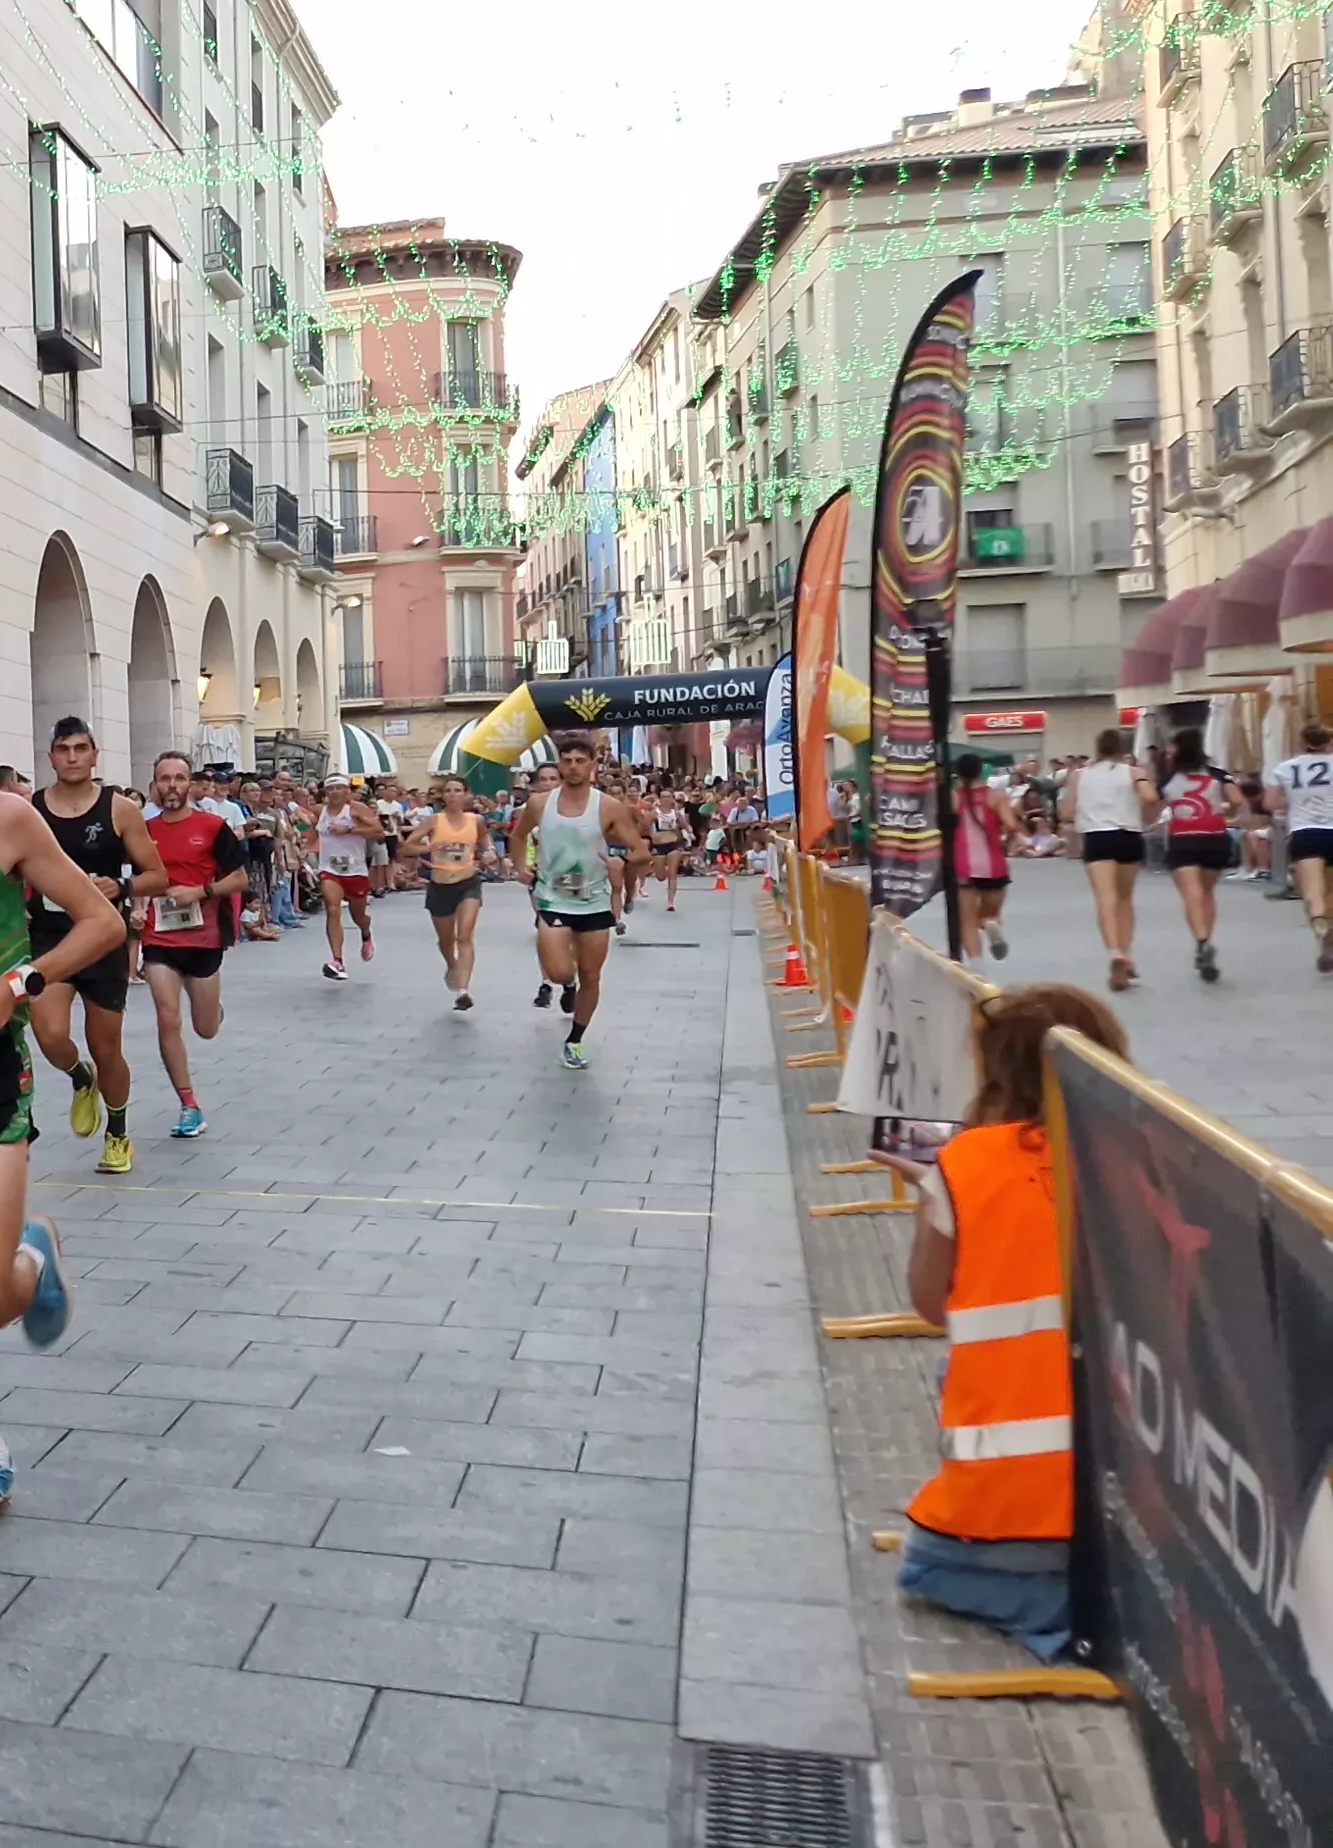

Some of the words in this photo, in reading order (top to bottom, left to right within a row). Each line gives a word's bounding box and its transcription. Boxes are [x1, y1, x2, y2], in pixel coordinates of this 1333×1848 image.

[1128, 442, 1152, 567] HOSTAL
[634, 679, 756, 705] FUNDACIÓN
[604, 710, 642, 721] CAJA
[647, 707, 694, 718] RURAL
[700, 703, 718, 714] DE
[986, 715, 1025, 728] GAES
[779, 673, 794, 786] OrtoAvanza
[1290, 761, 1330, 789] 12
